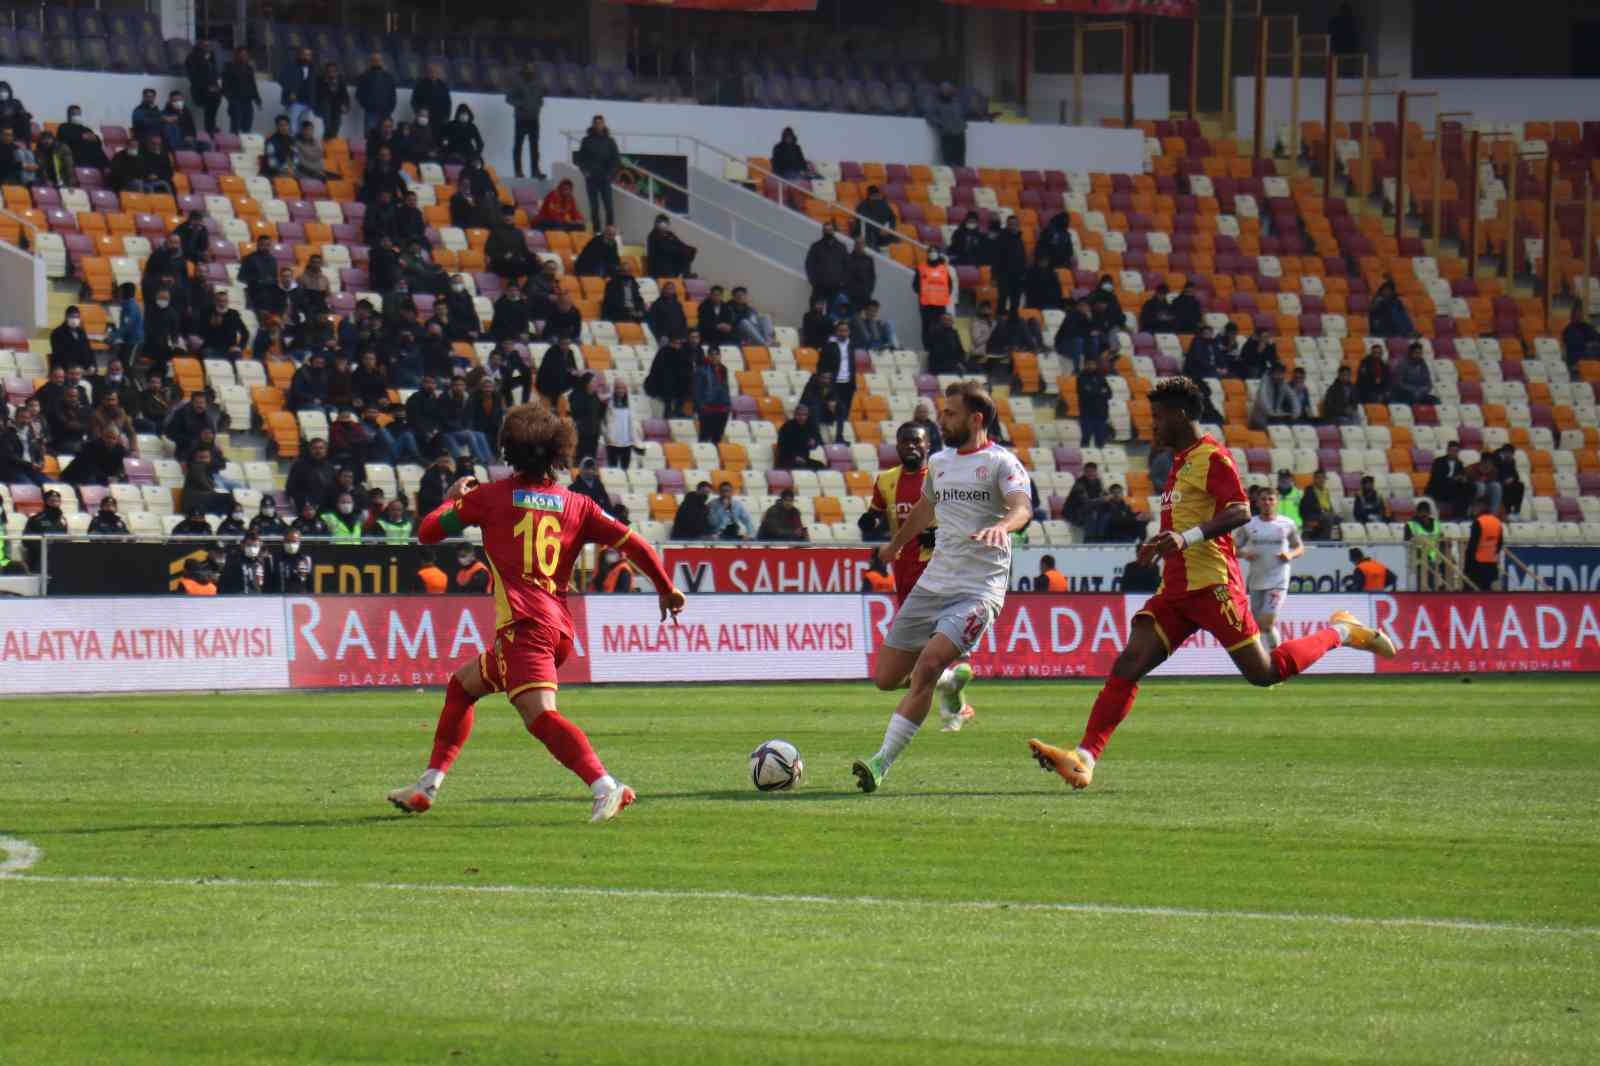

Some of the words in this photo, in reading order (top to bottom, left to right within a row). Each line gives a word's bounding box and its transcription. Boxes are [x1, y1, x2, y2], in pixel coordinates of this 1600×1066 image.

[523, 495, 555, 507] AKSA
[943, 488, 990, 501] bitexen
[513, 511, 561, 577] 16
[1371, 595, 1600, 650] RAMADA
[111, 629, 183, 659] ALTIN
[193, 627, 272, 658] KAYISI
[603, 624, 711, 652] MALATYA
[717, 623, 778, 652] ALTIN
[786, 623, 853, 652] KAYISI
[1002, 664, 1086, 676] WYNDHAM
[1411, 660, 1461, 672] PLAZA
[1469, 660, 1487, 671] BY
[1495, 659, 1572, 671] WYNDHAM
[338, 672, 400, 686] PLAZA
[412, 671, 433, 684] BY
